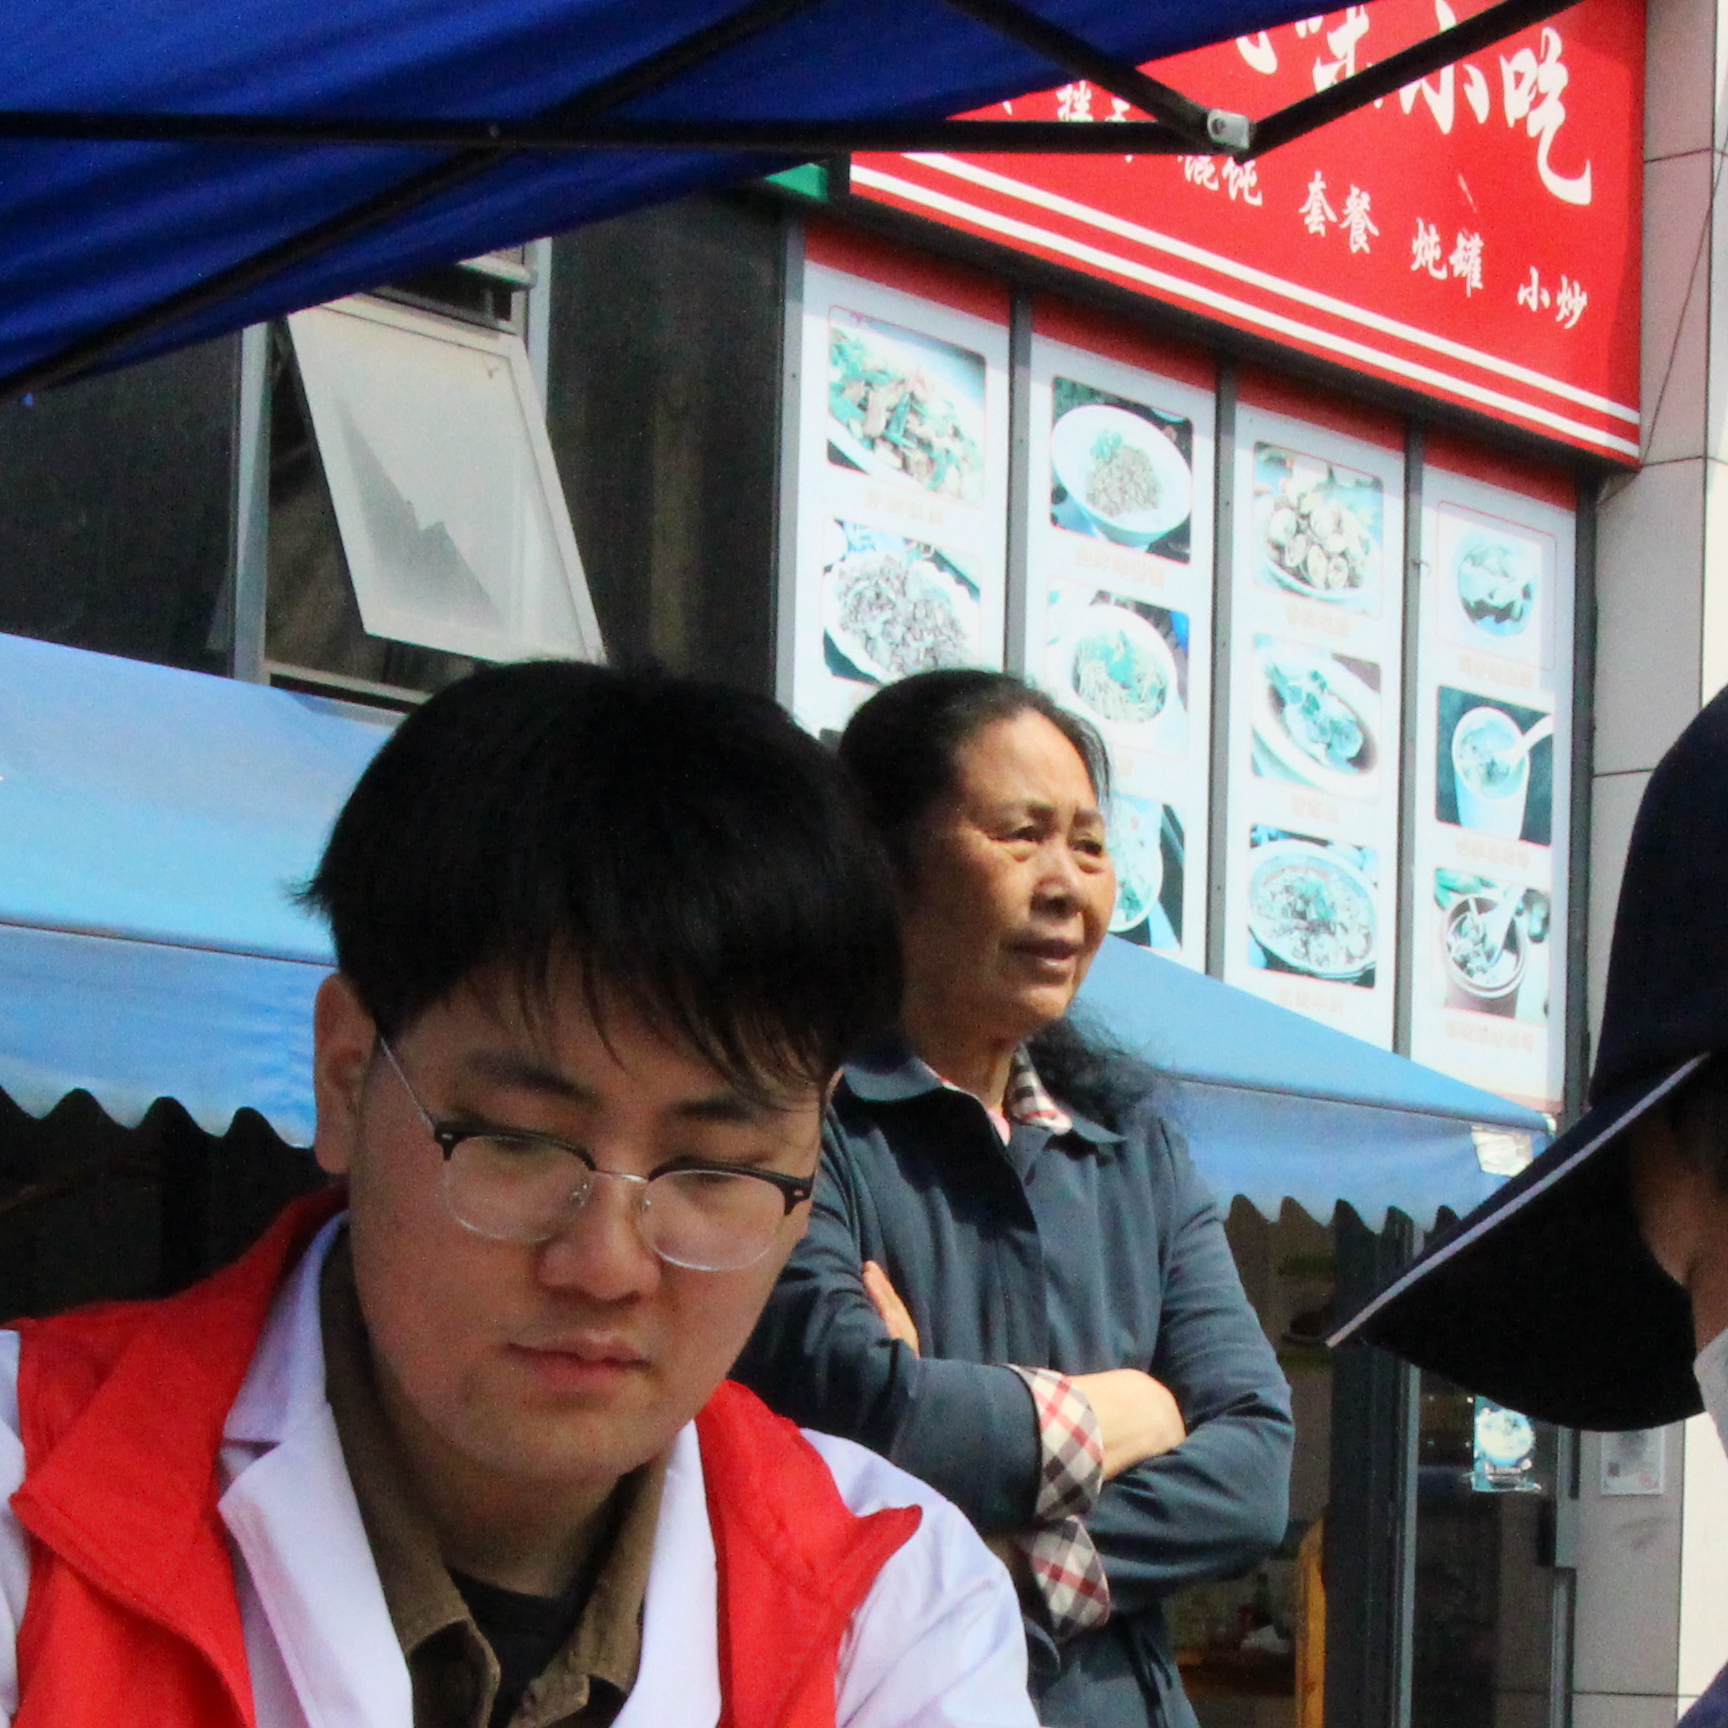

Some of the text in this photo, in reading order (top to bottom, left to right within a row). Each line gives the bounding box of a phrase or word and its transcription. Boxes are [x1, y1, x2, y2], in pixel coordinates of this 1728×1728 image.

[1298, 170, 1380, 253] 套餐
[1410, 217, 1484, 297] 炖罐
[1517, 266, 1588, 329] 小炒
